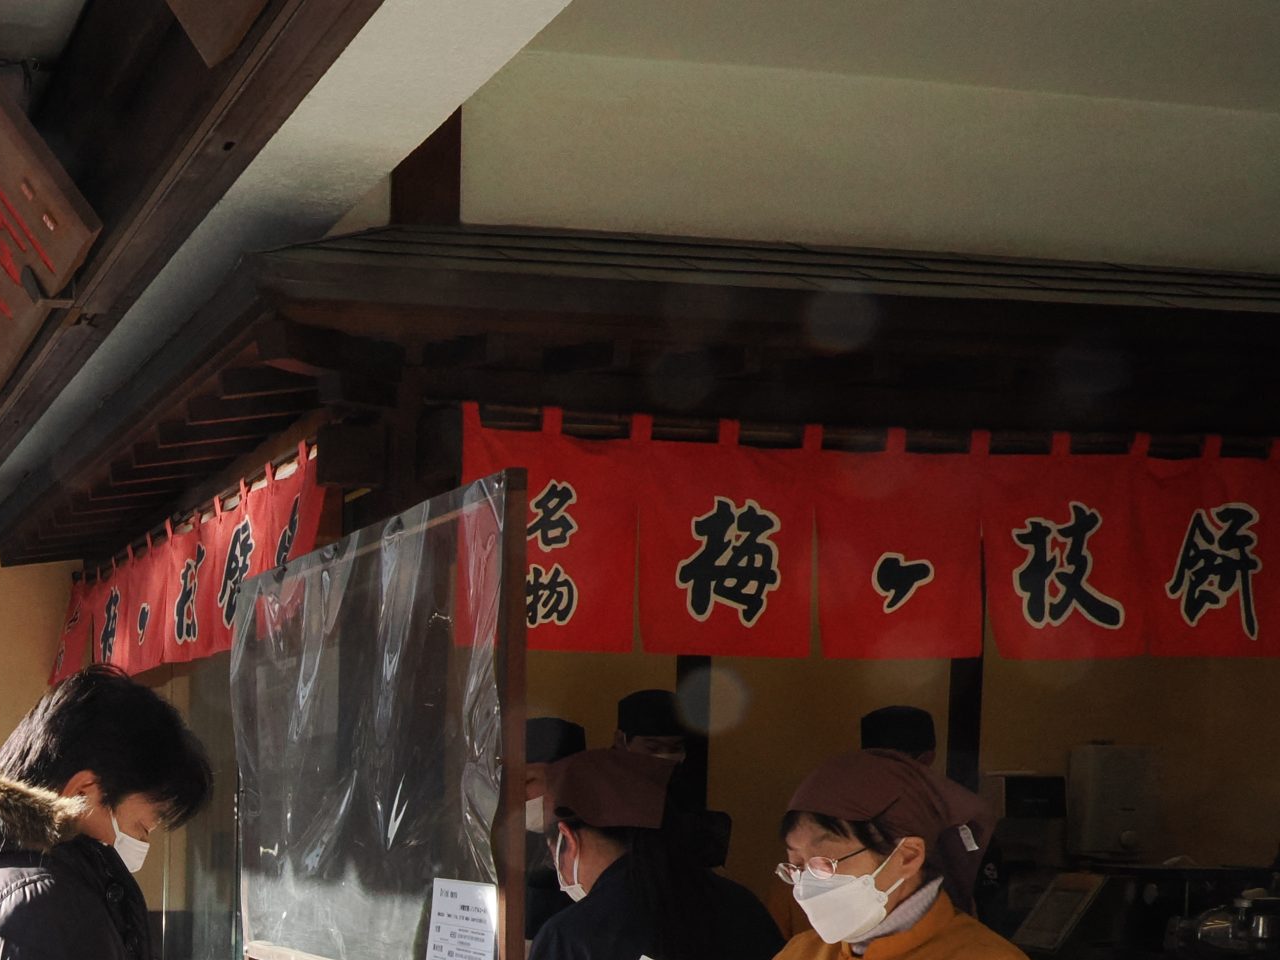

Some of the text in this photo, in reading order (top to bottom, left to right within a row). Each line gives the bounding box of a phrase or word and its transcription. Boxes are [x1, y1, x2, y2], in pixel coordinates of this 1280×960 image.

[526, 480, 578, 628] 名物
[676, 495, 1263, 642] 梅ヶ枝餅
